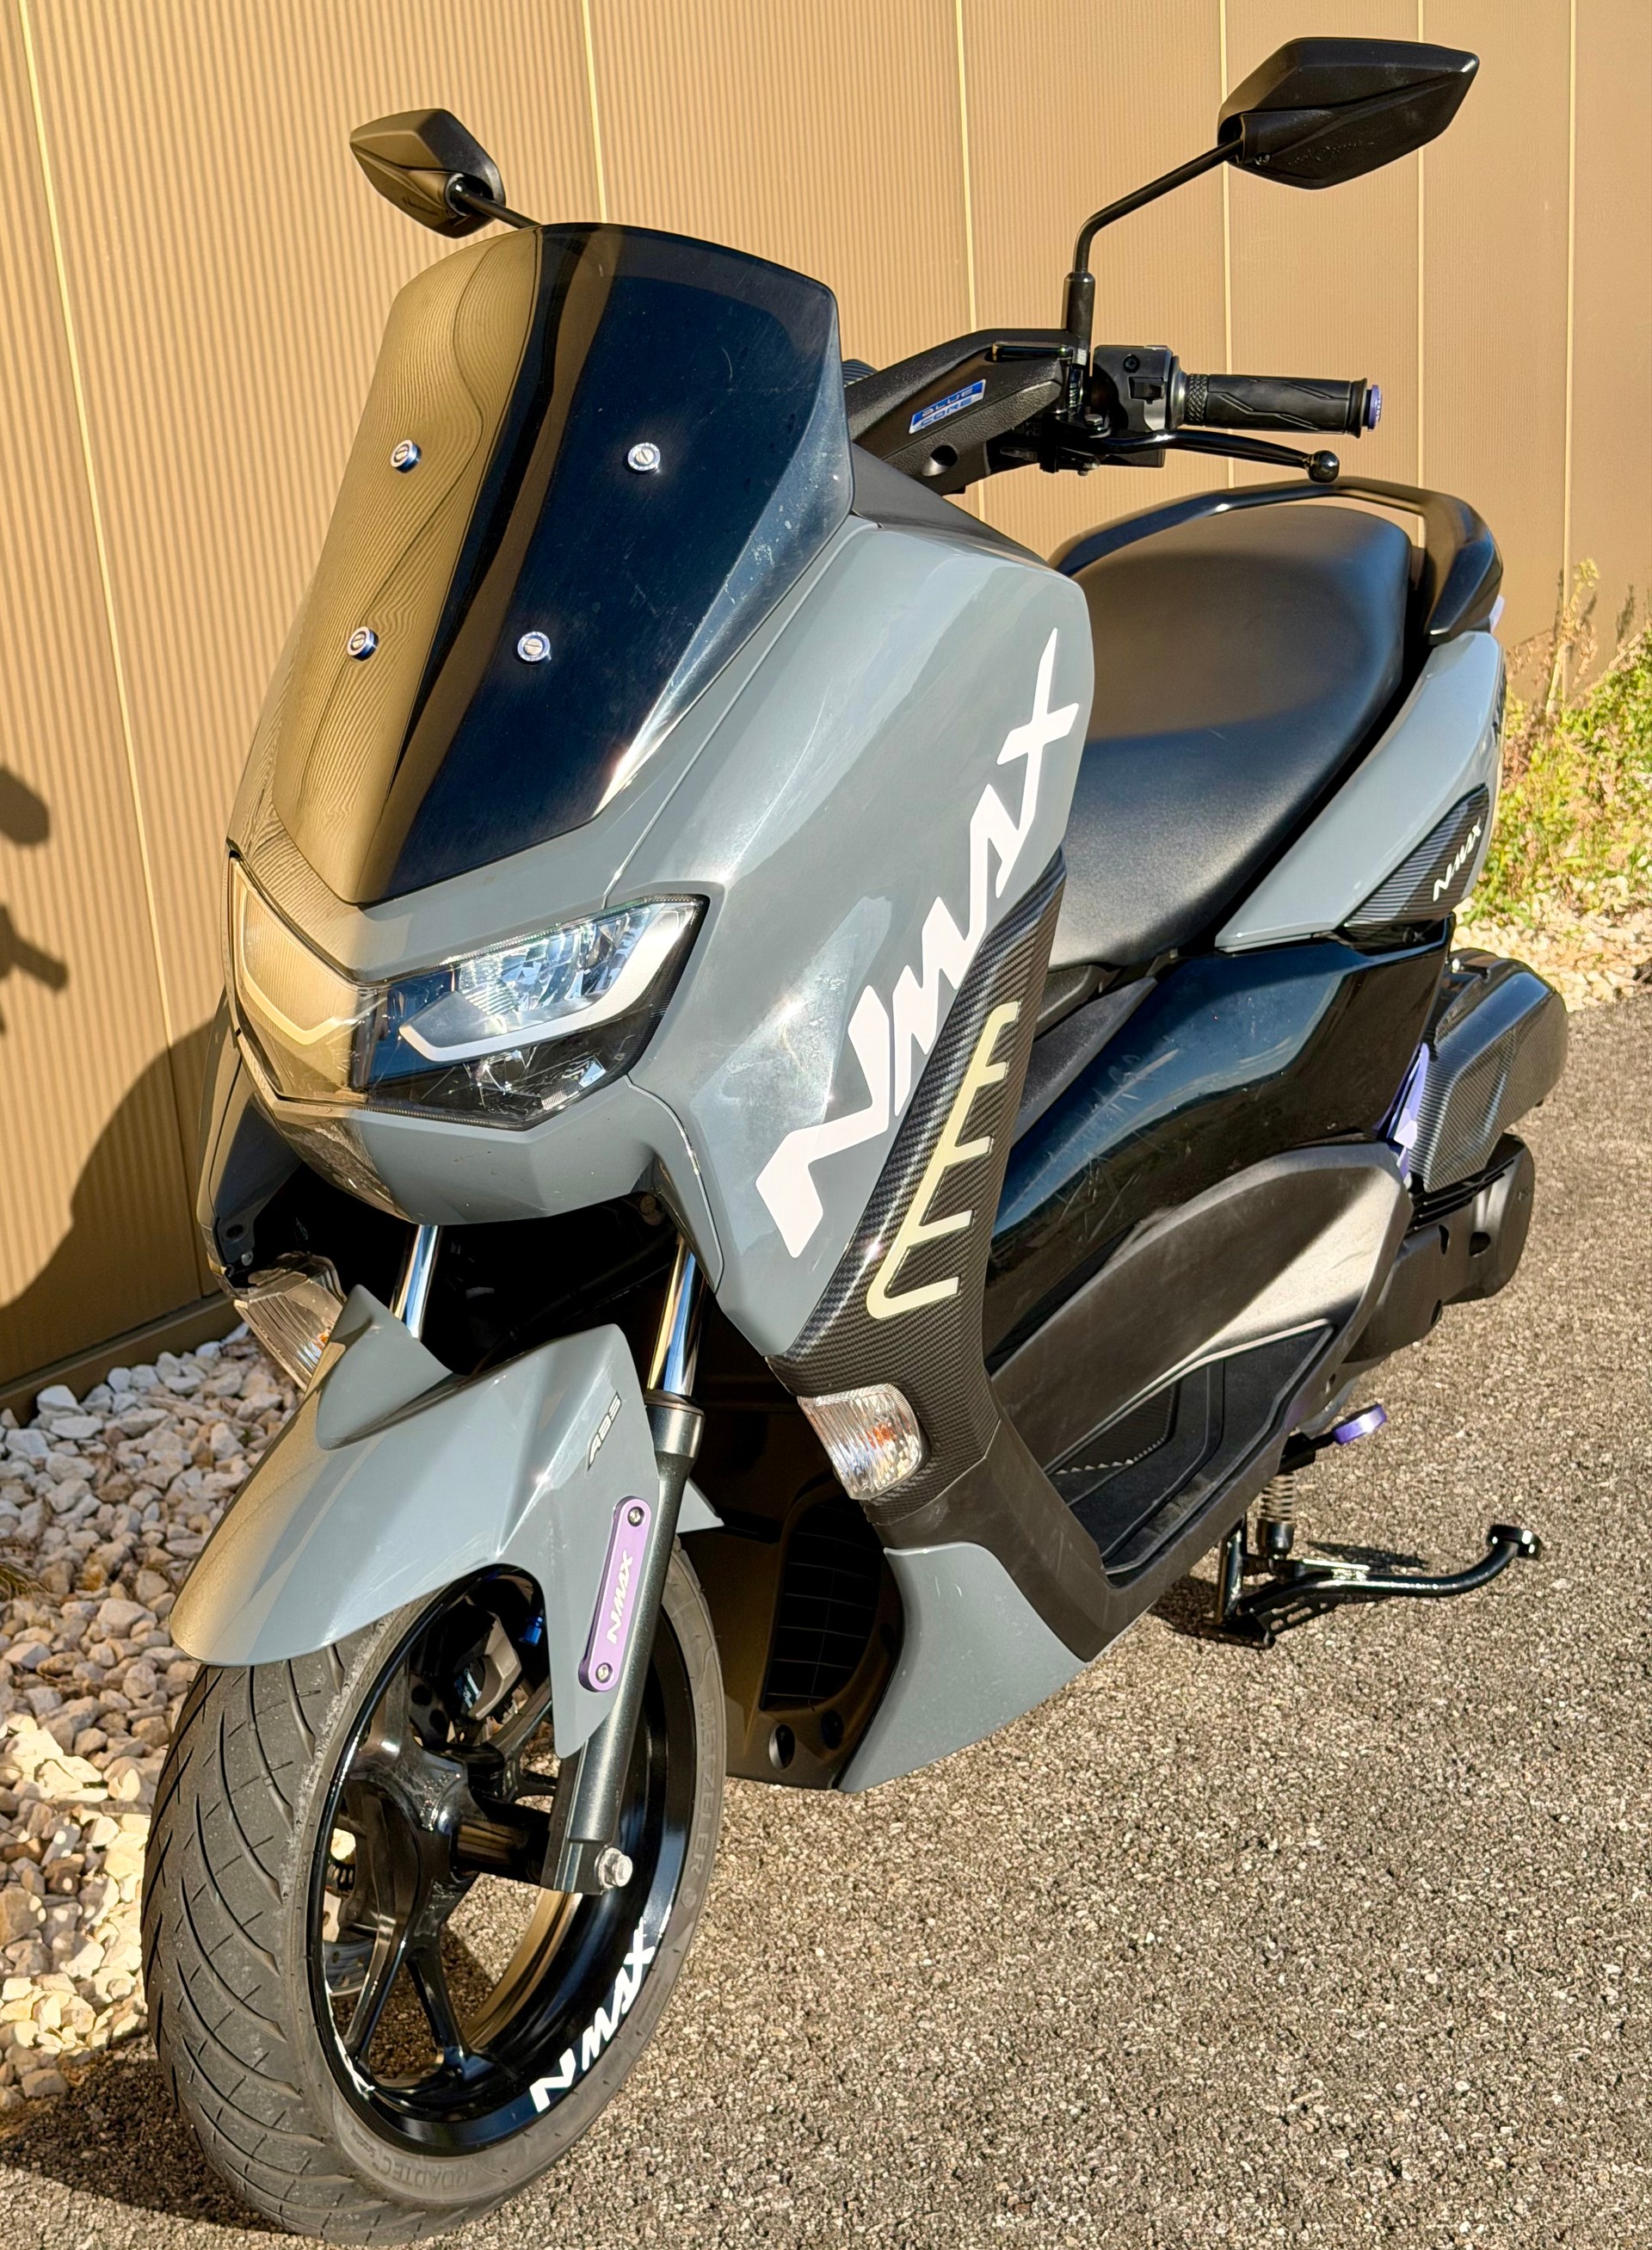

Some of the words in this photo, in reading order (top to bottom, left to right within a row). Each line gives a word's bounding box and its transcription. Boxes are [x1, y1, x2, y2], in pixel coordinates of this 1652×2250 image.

[921, 398, 971, 425] CORE
[755, 627, 1079, 1258] NMAX
[606, 1550, 632, 1644] NMAX
[690, 1699, 716, 1877] METZELER
[529, 1918, 655, 2112] NMAX
